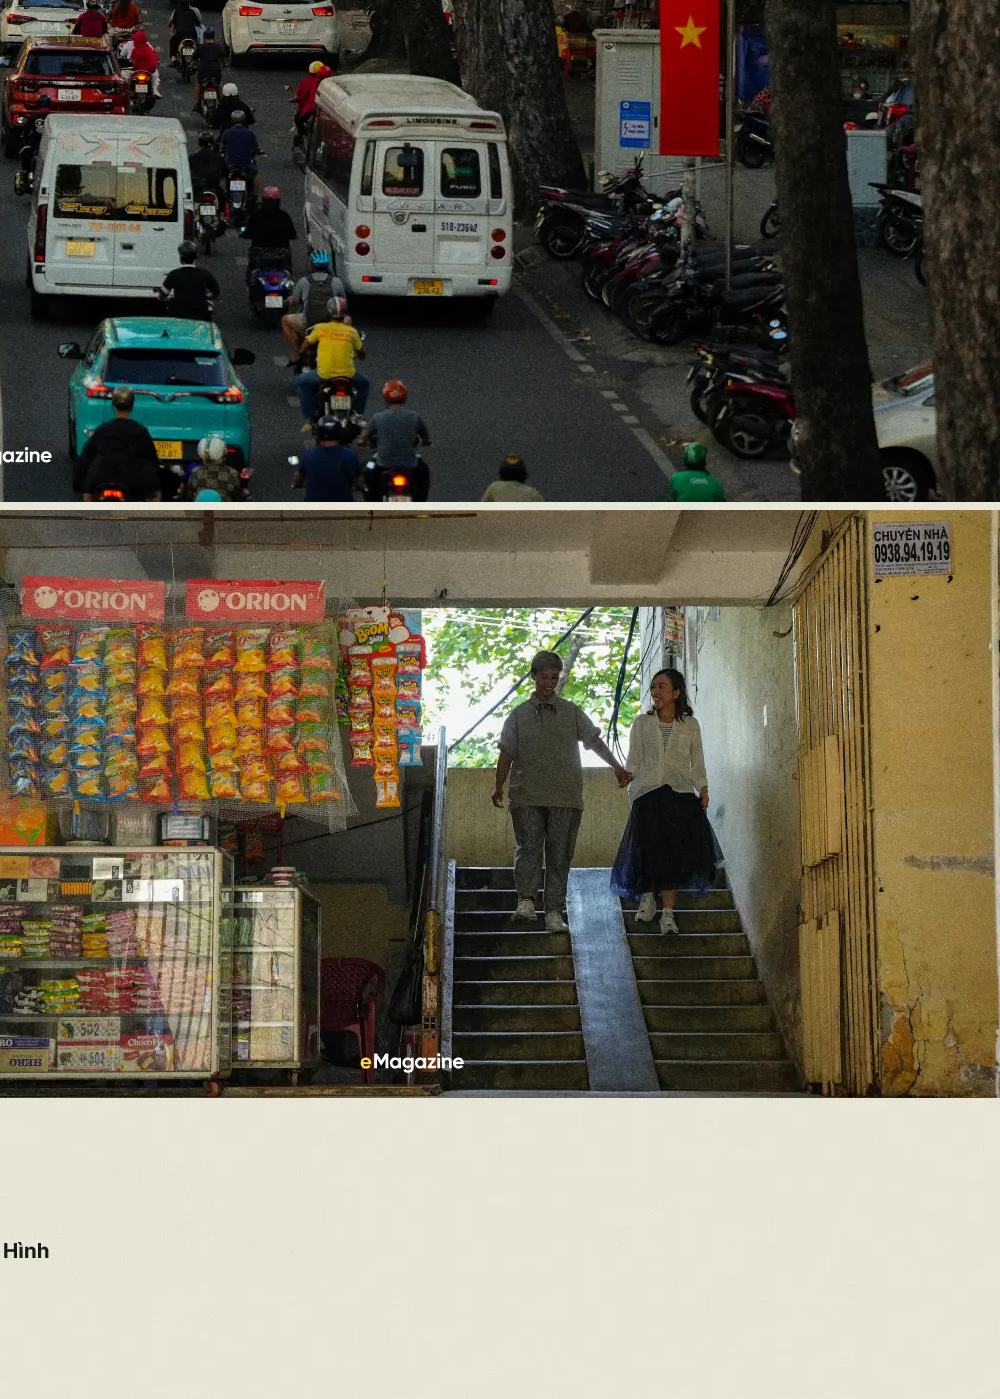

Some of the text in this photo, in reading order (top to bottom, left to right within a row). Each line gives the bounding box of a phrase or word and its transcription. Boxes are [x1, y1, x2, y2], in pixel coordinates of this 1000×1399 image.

[406, 117, 457, 125] LIMOUSINE
[874, 541, 950, 563] 0938.94.19.19
[64, 589, 147, 612] ORION
[225, 591, 308, 612] ORION
[9, 1057, 42, 1067] HERO
